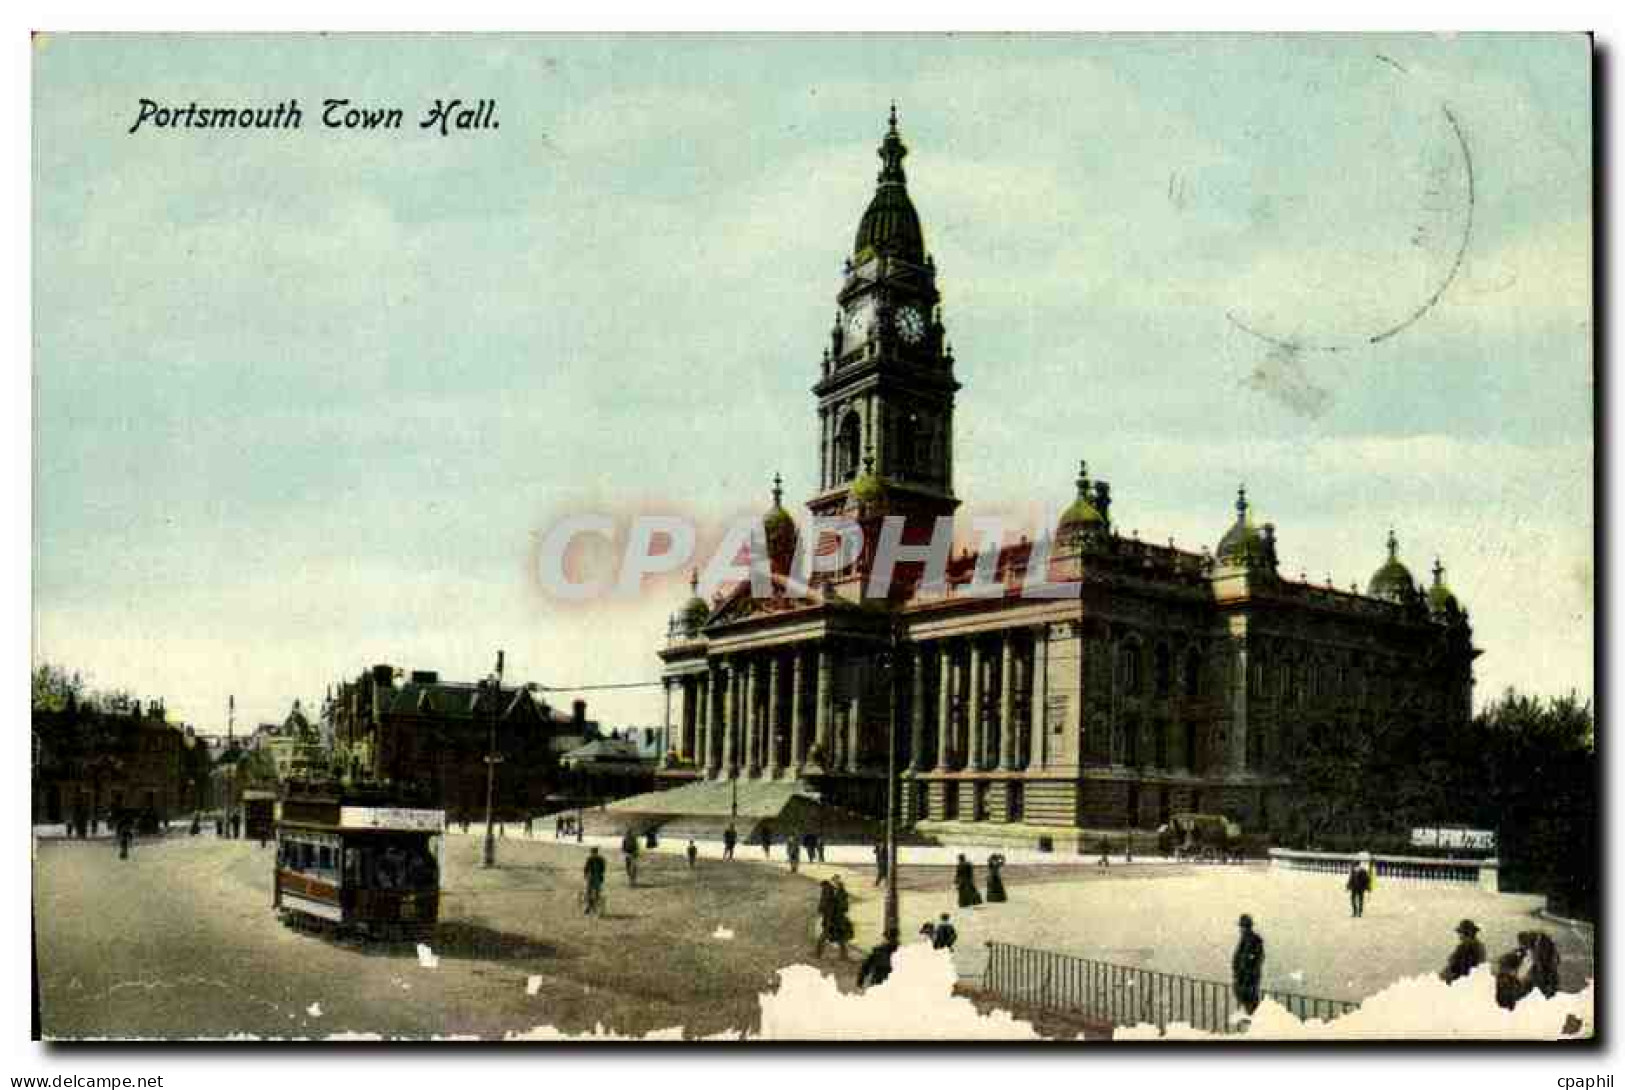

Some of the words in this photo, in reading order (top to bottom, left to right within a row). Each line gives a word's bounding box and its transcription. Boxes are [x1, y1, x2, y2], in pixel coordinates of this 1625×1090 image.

[129, 98, 302, 135] Portsmouth
[322, 98, 404, 129] Town
[420, 98, 500, 136] Hall.
